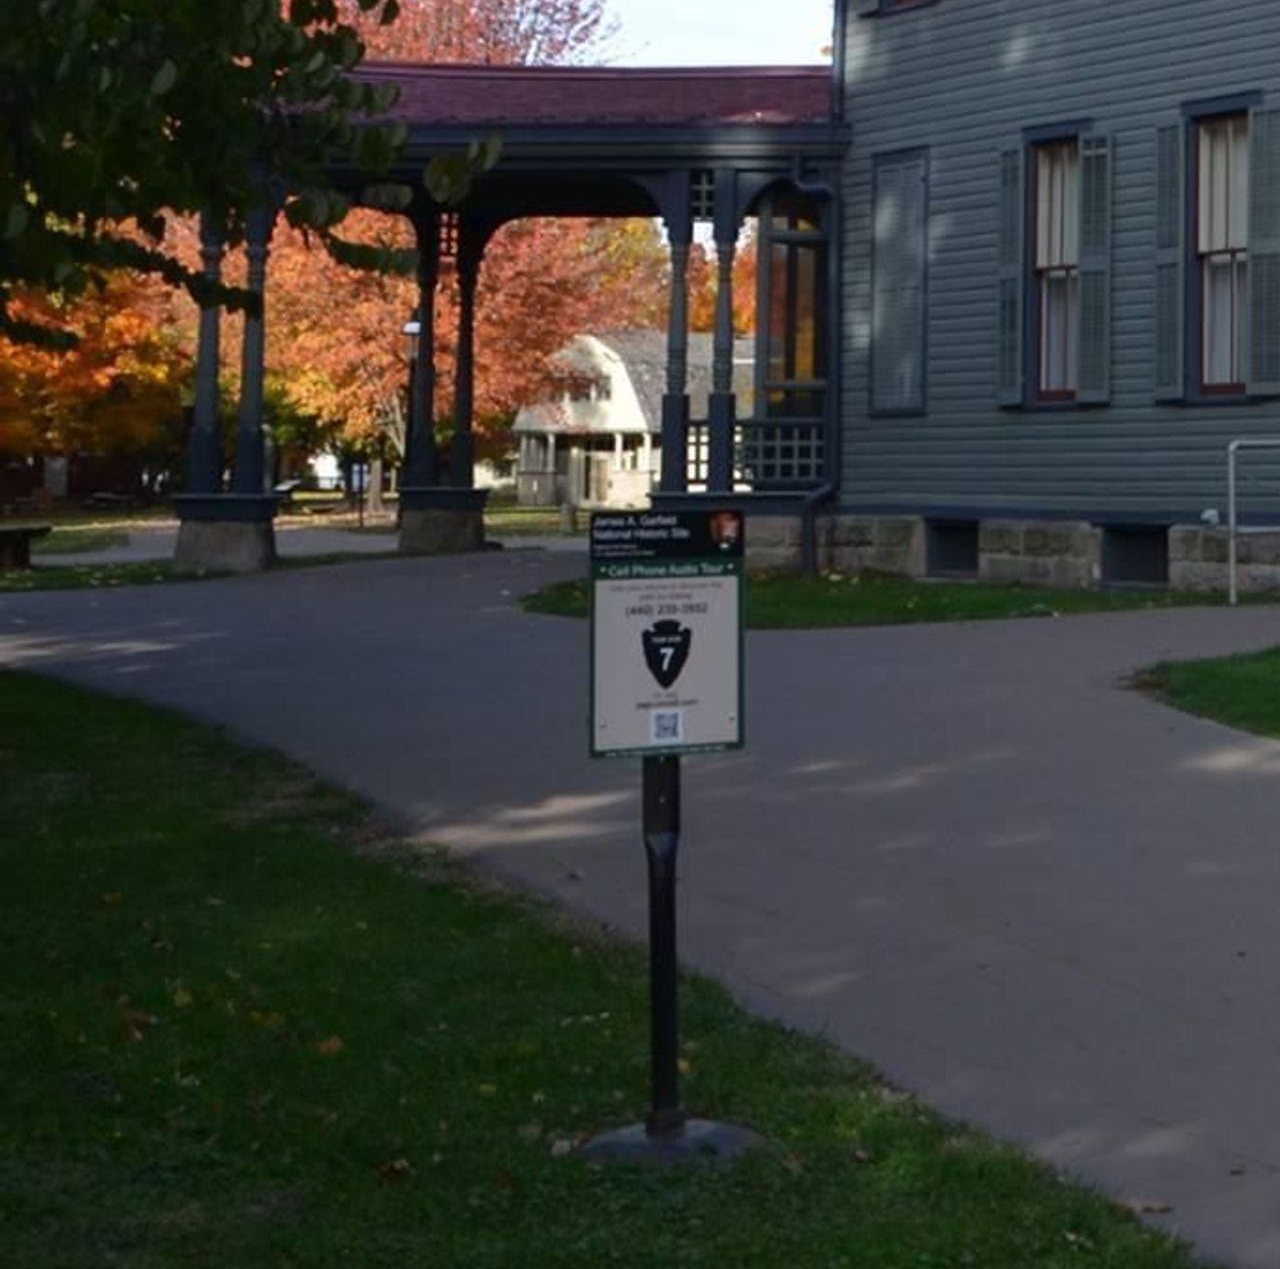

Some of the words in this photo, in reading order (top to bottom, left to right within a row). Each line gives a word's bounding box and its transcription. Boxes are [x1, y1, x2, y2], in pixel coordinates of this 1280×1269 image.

[594, 516, 626, 528] James
[640, 514, 678, 527] Garfield
[594, 529, 632, 540] National
[634, 528, 669, 539] Historic
[671, 527, 691, 538] Site
[607, 564, 630, 576] Cell
[632, 564, 667, 575] Phone
[669, 563, 699, 574] Audio
[701, 562, 724, 574] Tour
[660, 646, 674, 672] 7
